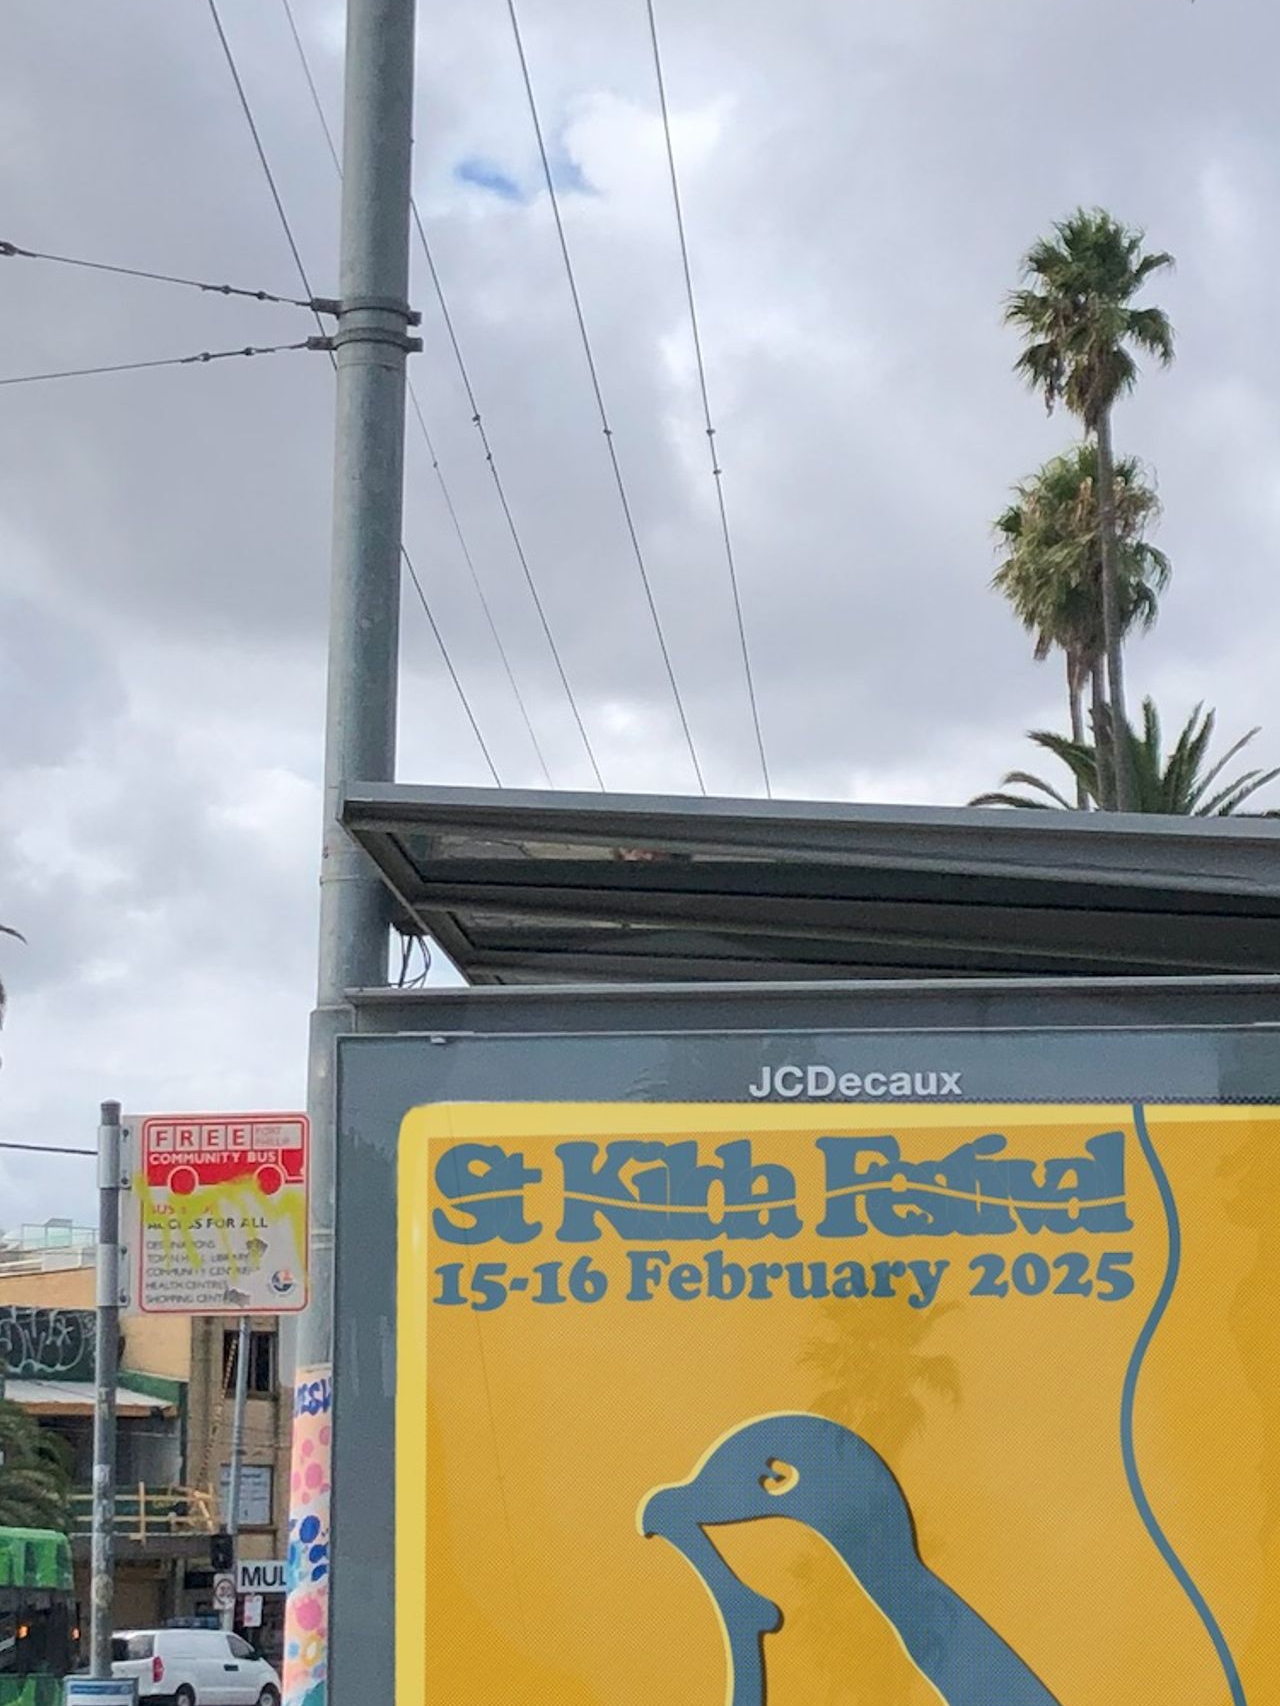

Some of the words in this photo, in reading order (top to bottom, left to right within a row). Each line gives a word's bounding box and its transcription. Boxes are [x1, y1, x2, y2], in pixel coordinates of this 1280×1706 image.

[747, 1064, 963, 1099] JCDecaux
[155, 1129, 246, 1148] FREE
[149, 1151, 241, 1165] COMMUNITY
[246, 1150, 277, 1163] BUS
[432, 1141, 544, 1244] St
[554, 1138, 805, 1242] Kilda
[814, 1131, 1136, 1238] Festival
[240, 1216, 269, 1228] ALL
[432, 1255, 609, 1312] 15-16
[625, 1249, 951, 1308] February
[968, 1250, 1136, 1302] 2025
